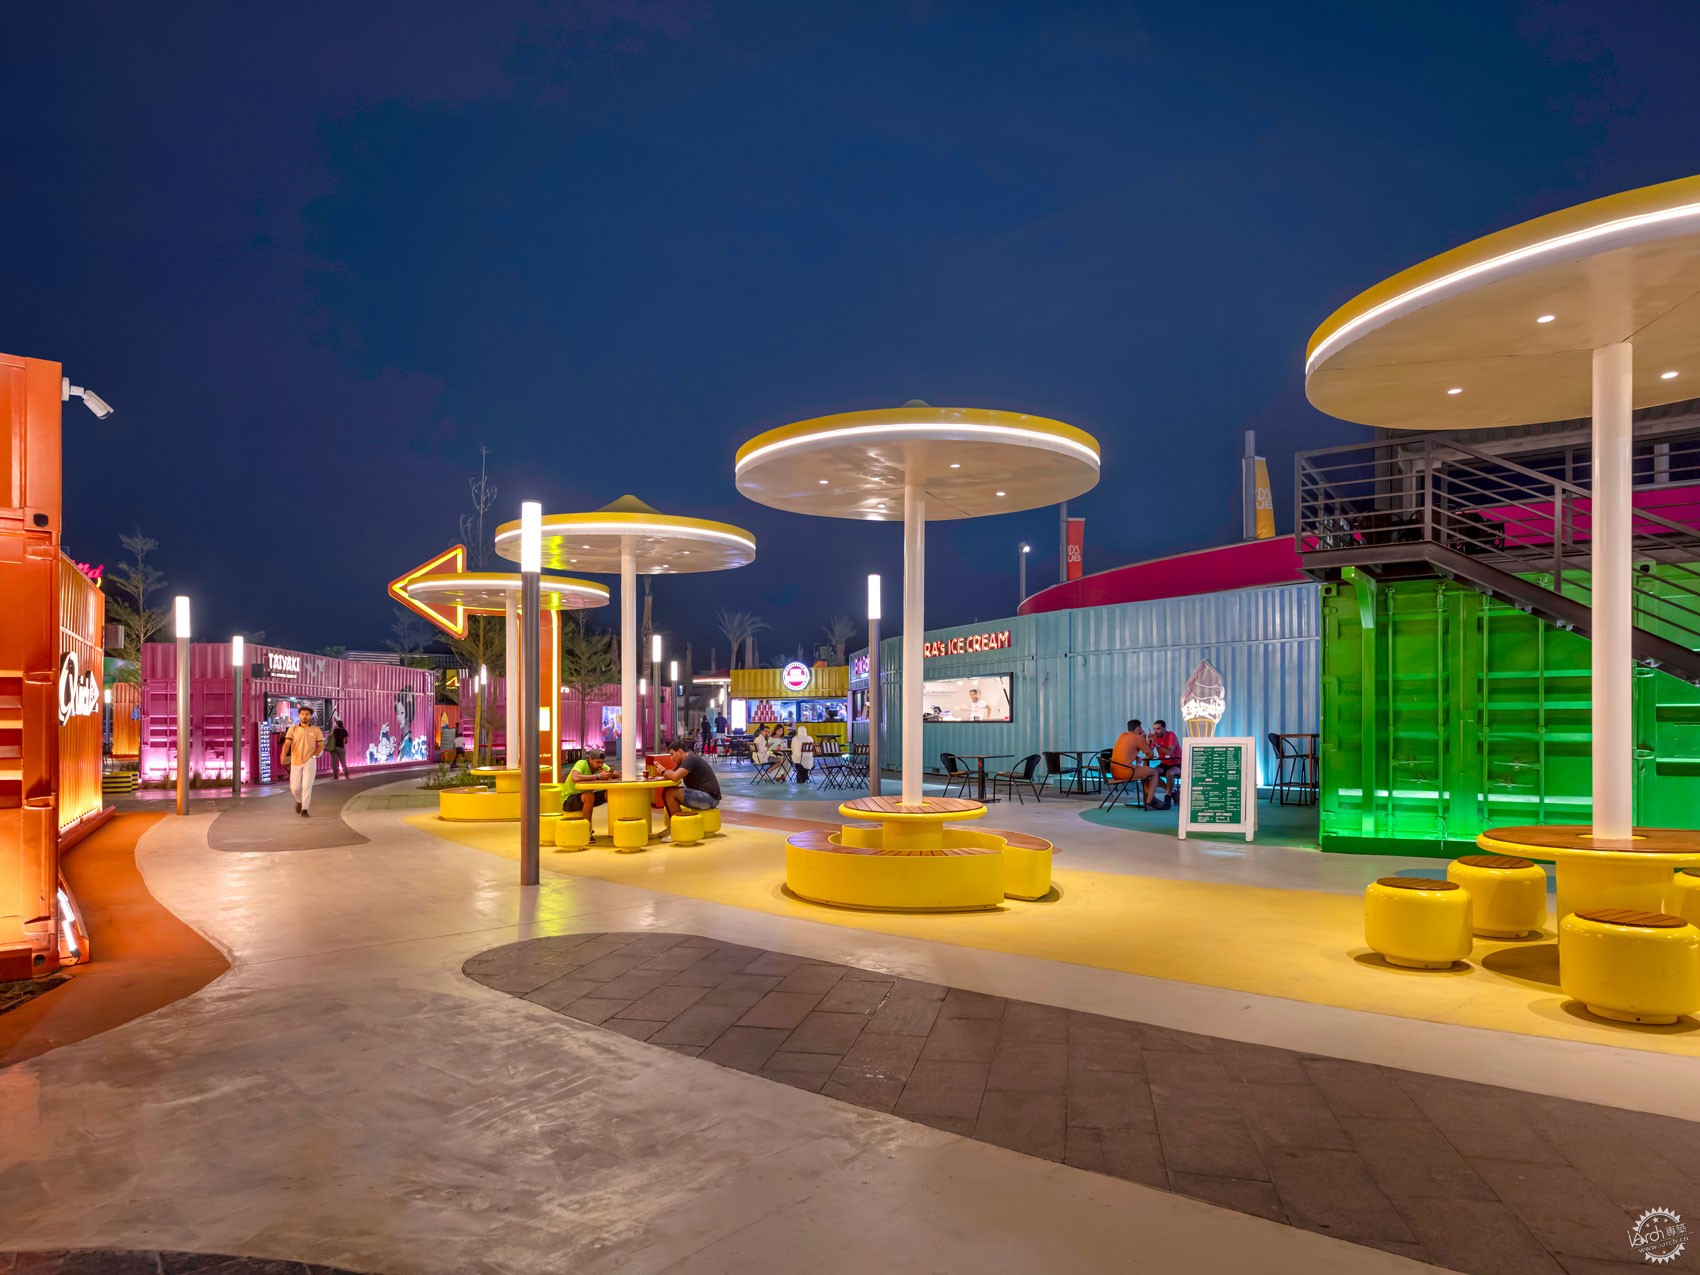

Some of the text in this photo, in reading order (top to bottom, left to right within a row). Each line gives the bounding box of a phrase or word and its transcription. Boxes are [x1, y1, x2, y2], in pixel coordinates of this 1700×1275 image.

[948, 637, 965, 655] ICE
[966, 629, 1011, 652] CREAM
[268, 652, 301, 672] TAIYAKI
